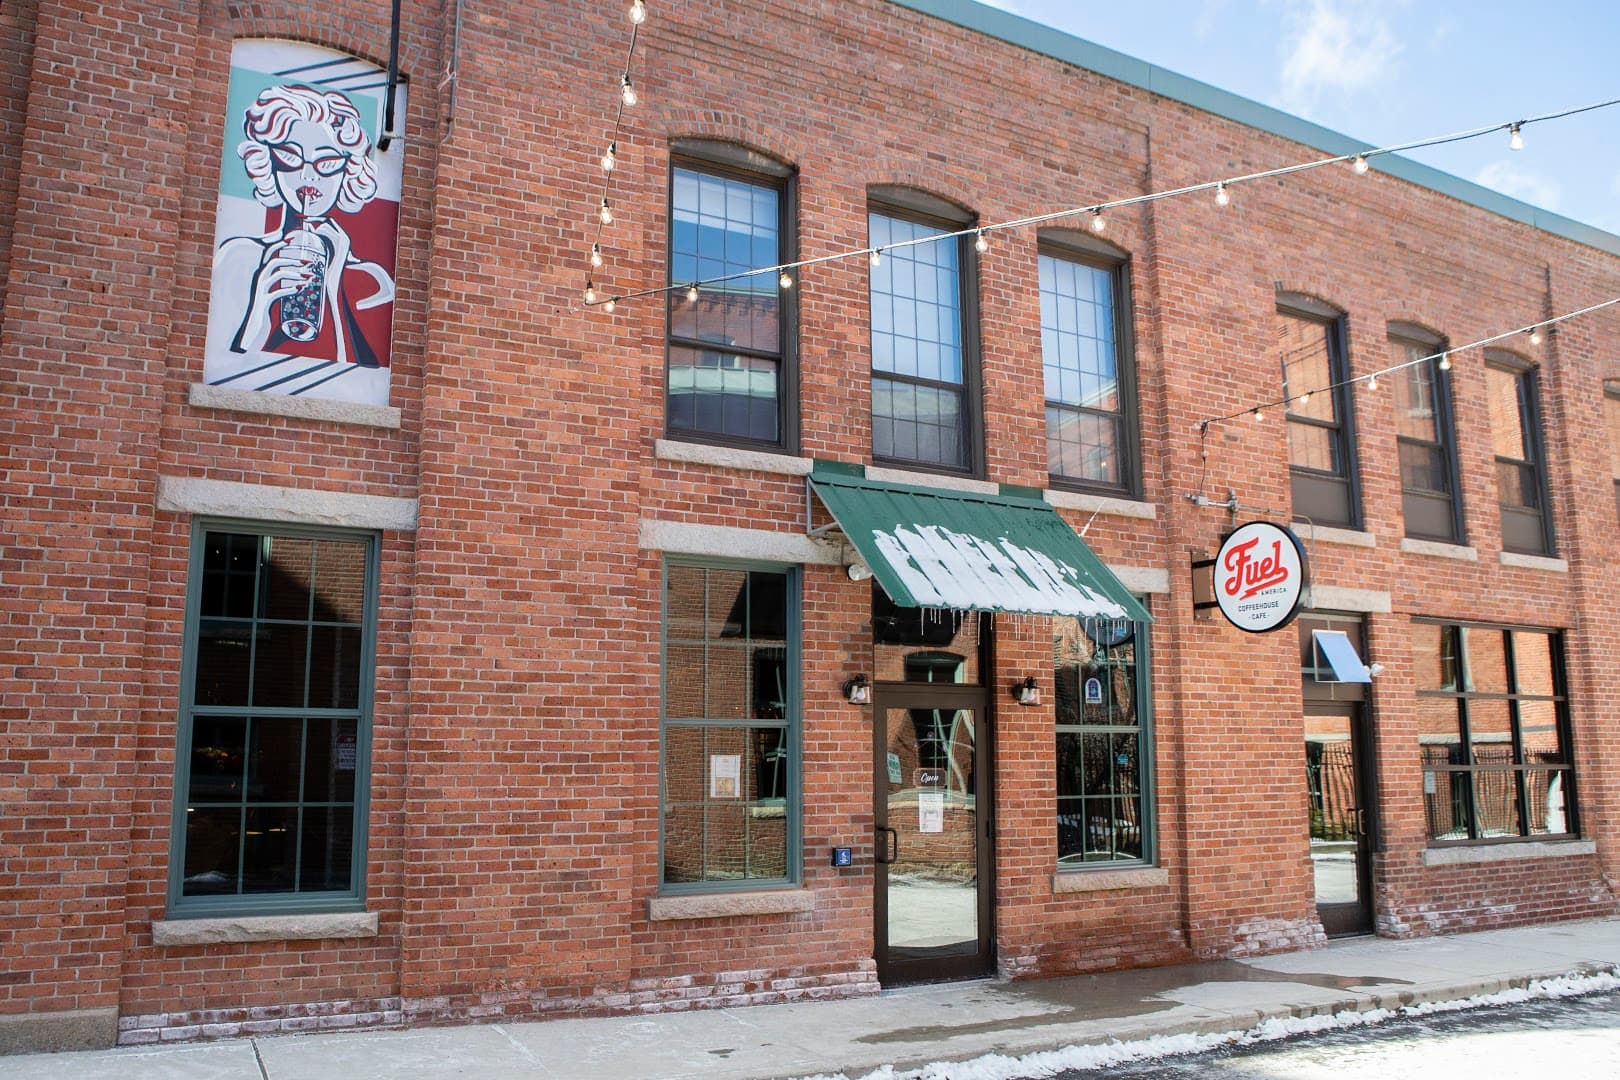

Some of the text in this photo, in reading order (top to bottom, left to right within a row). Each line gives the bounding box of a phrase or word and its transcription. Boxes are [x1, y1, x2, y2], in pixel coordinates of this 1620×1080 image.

[1225, 537, 1288, 597] Fuel
[1261, 587, 1287, 596] AMERICA
[1238, 600, 1279, 612] COFFEEHOUSE
[920, 772, 939, 784] Open
